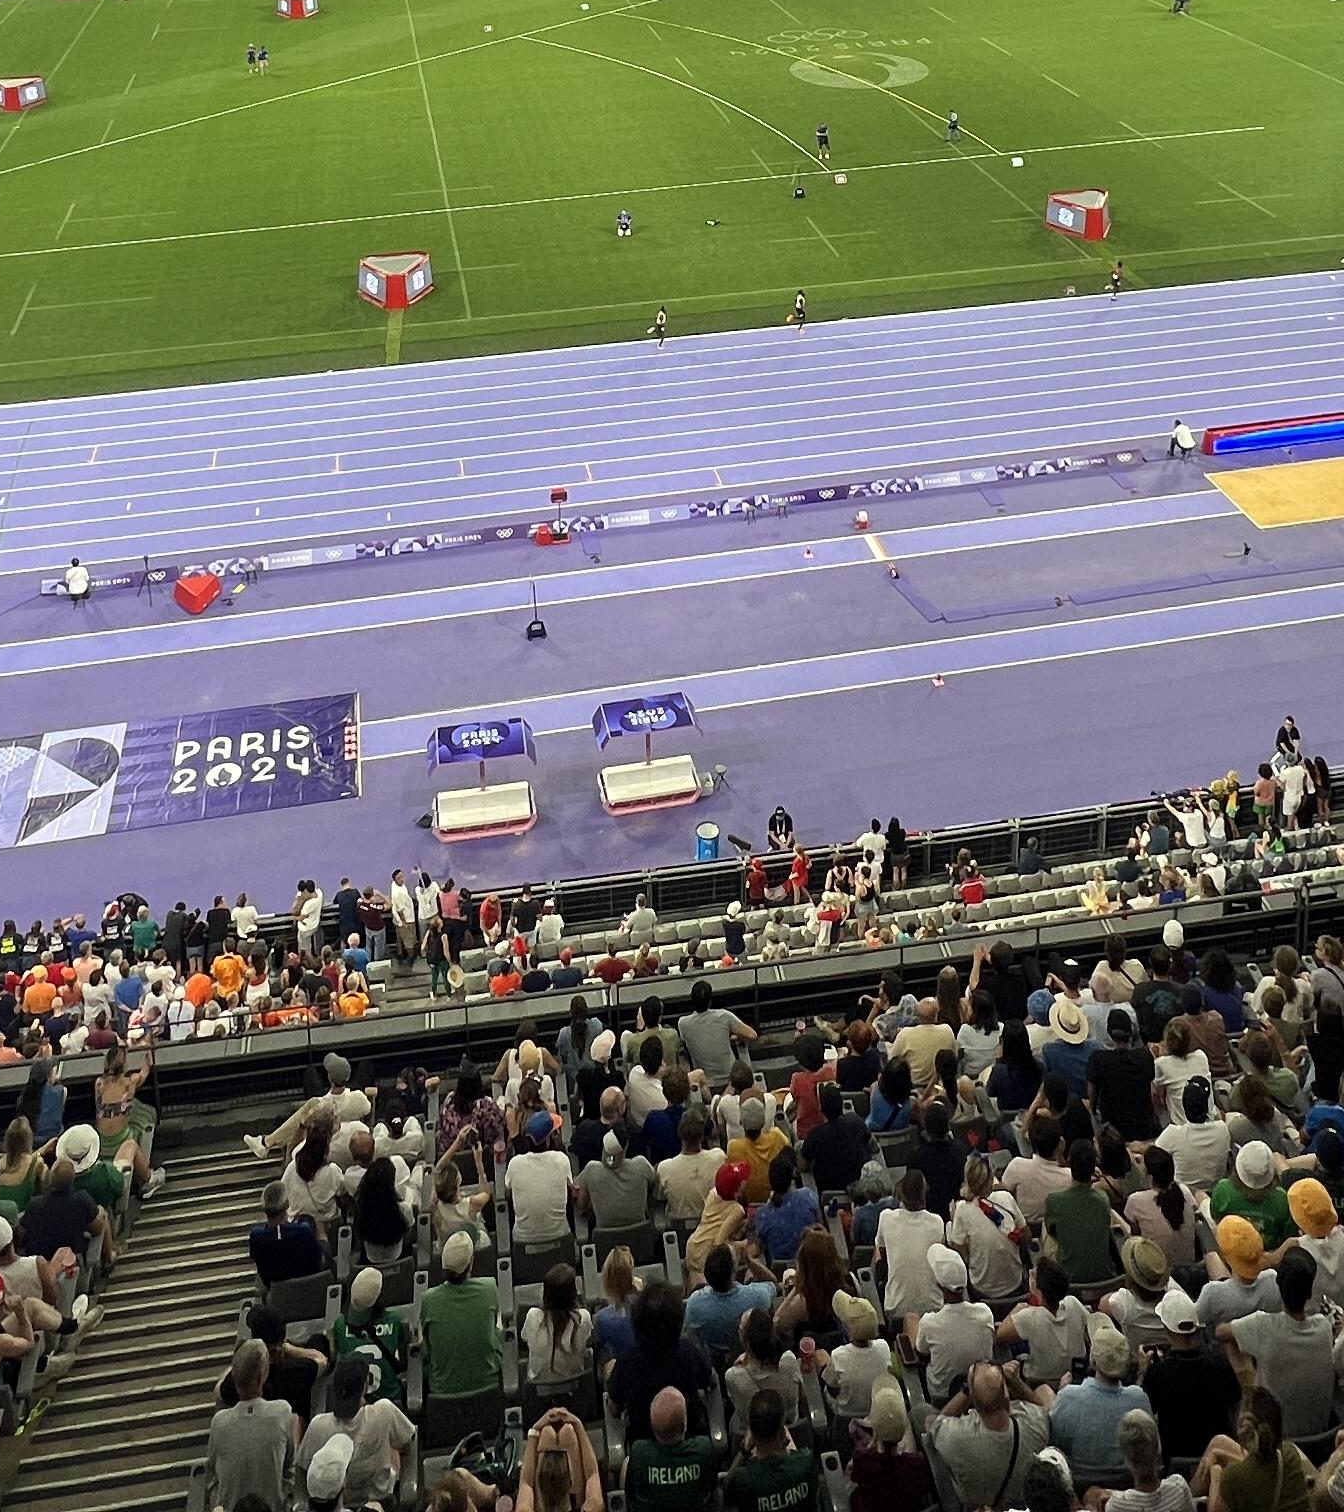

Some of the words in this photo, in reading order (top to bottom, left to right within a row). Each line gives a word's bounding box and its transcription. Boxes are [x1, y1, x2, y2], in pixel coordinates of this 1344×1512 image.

[174, 725, 310, 767] PARIS
[461, 728, 499, 739] PARIS
[462, 735, 503, 748] 2024
[171, 753, 310, 795] 2024
[648, 1464, 701, 1485] IRELAND
[759, 1482, 809, 1512] IRELAND
